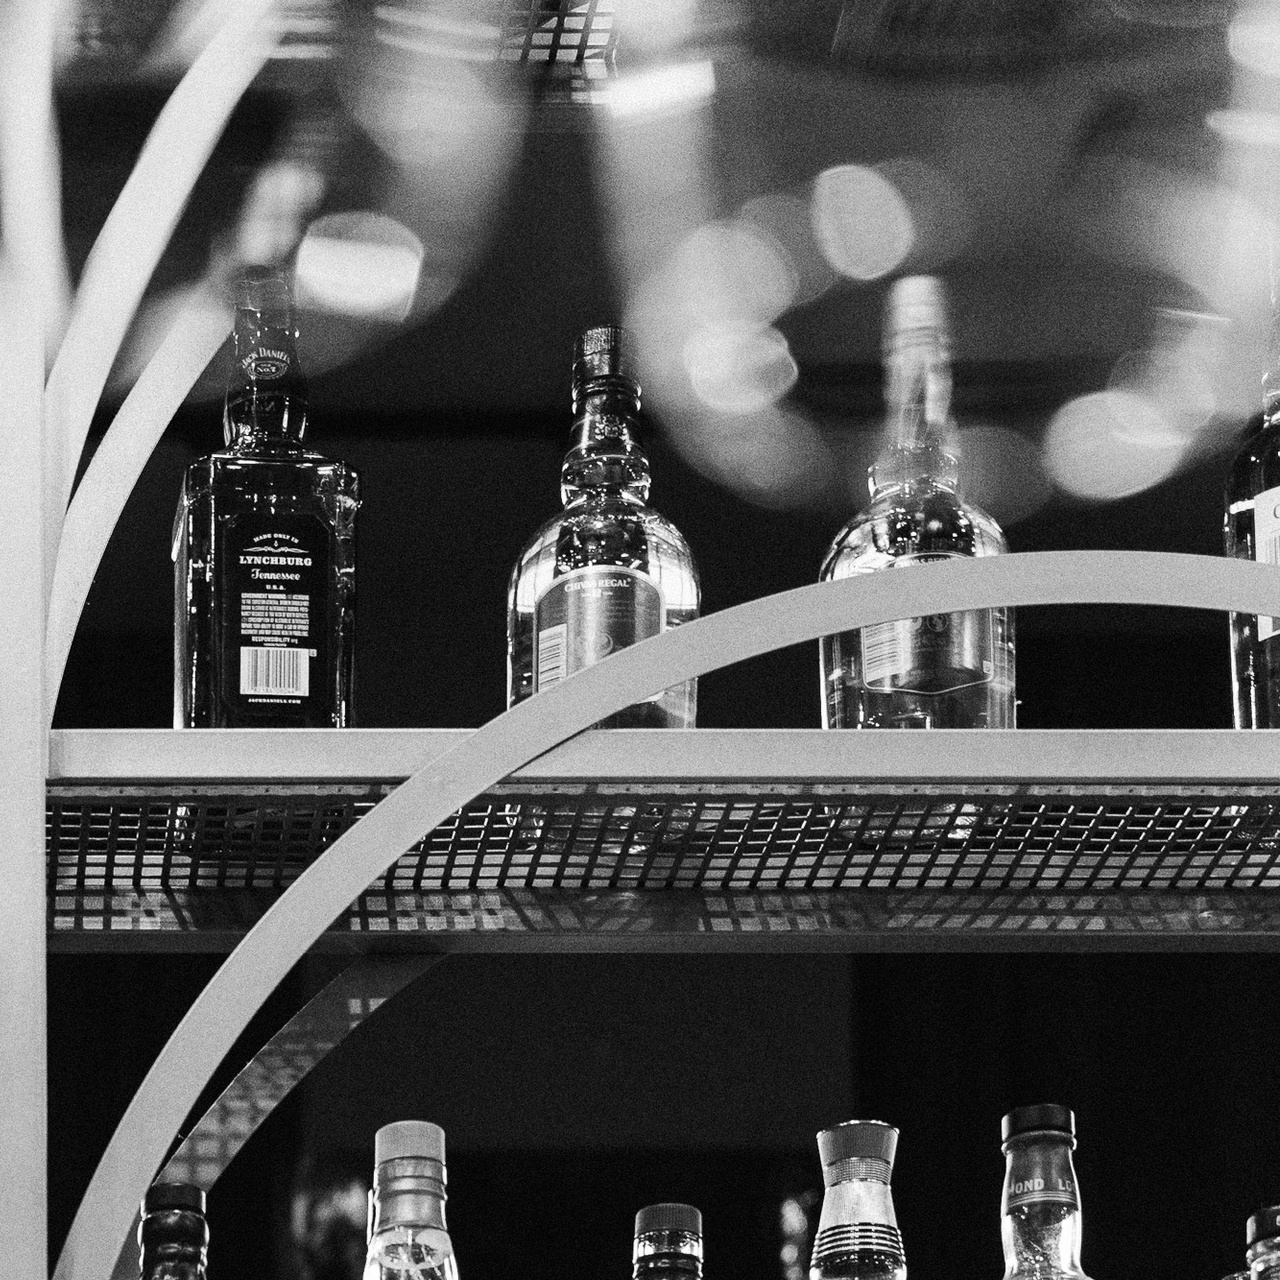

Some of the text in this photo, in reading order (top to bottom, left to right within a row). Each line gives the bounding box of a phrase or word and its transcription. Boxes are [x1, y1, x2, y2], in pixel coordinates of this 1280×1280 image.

[253, 533, 272, 543] MADE
[239, 555, 313, 567] LYNCHBURG
[251, 568, 301, 580] Tennessee
[599, 580, 629, 588] REGAL
